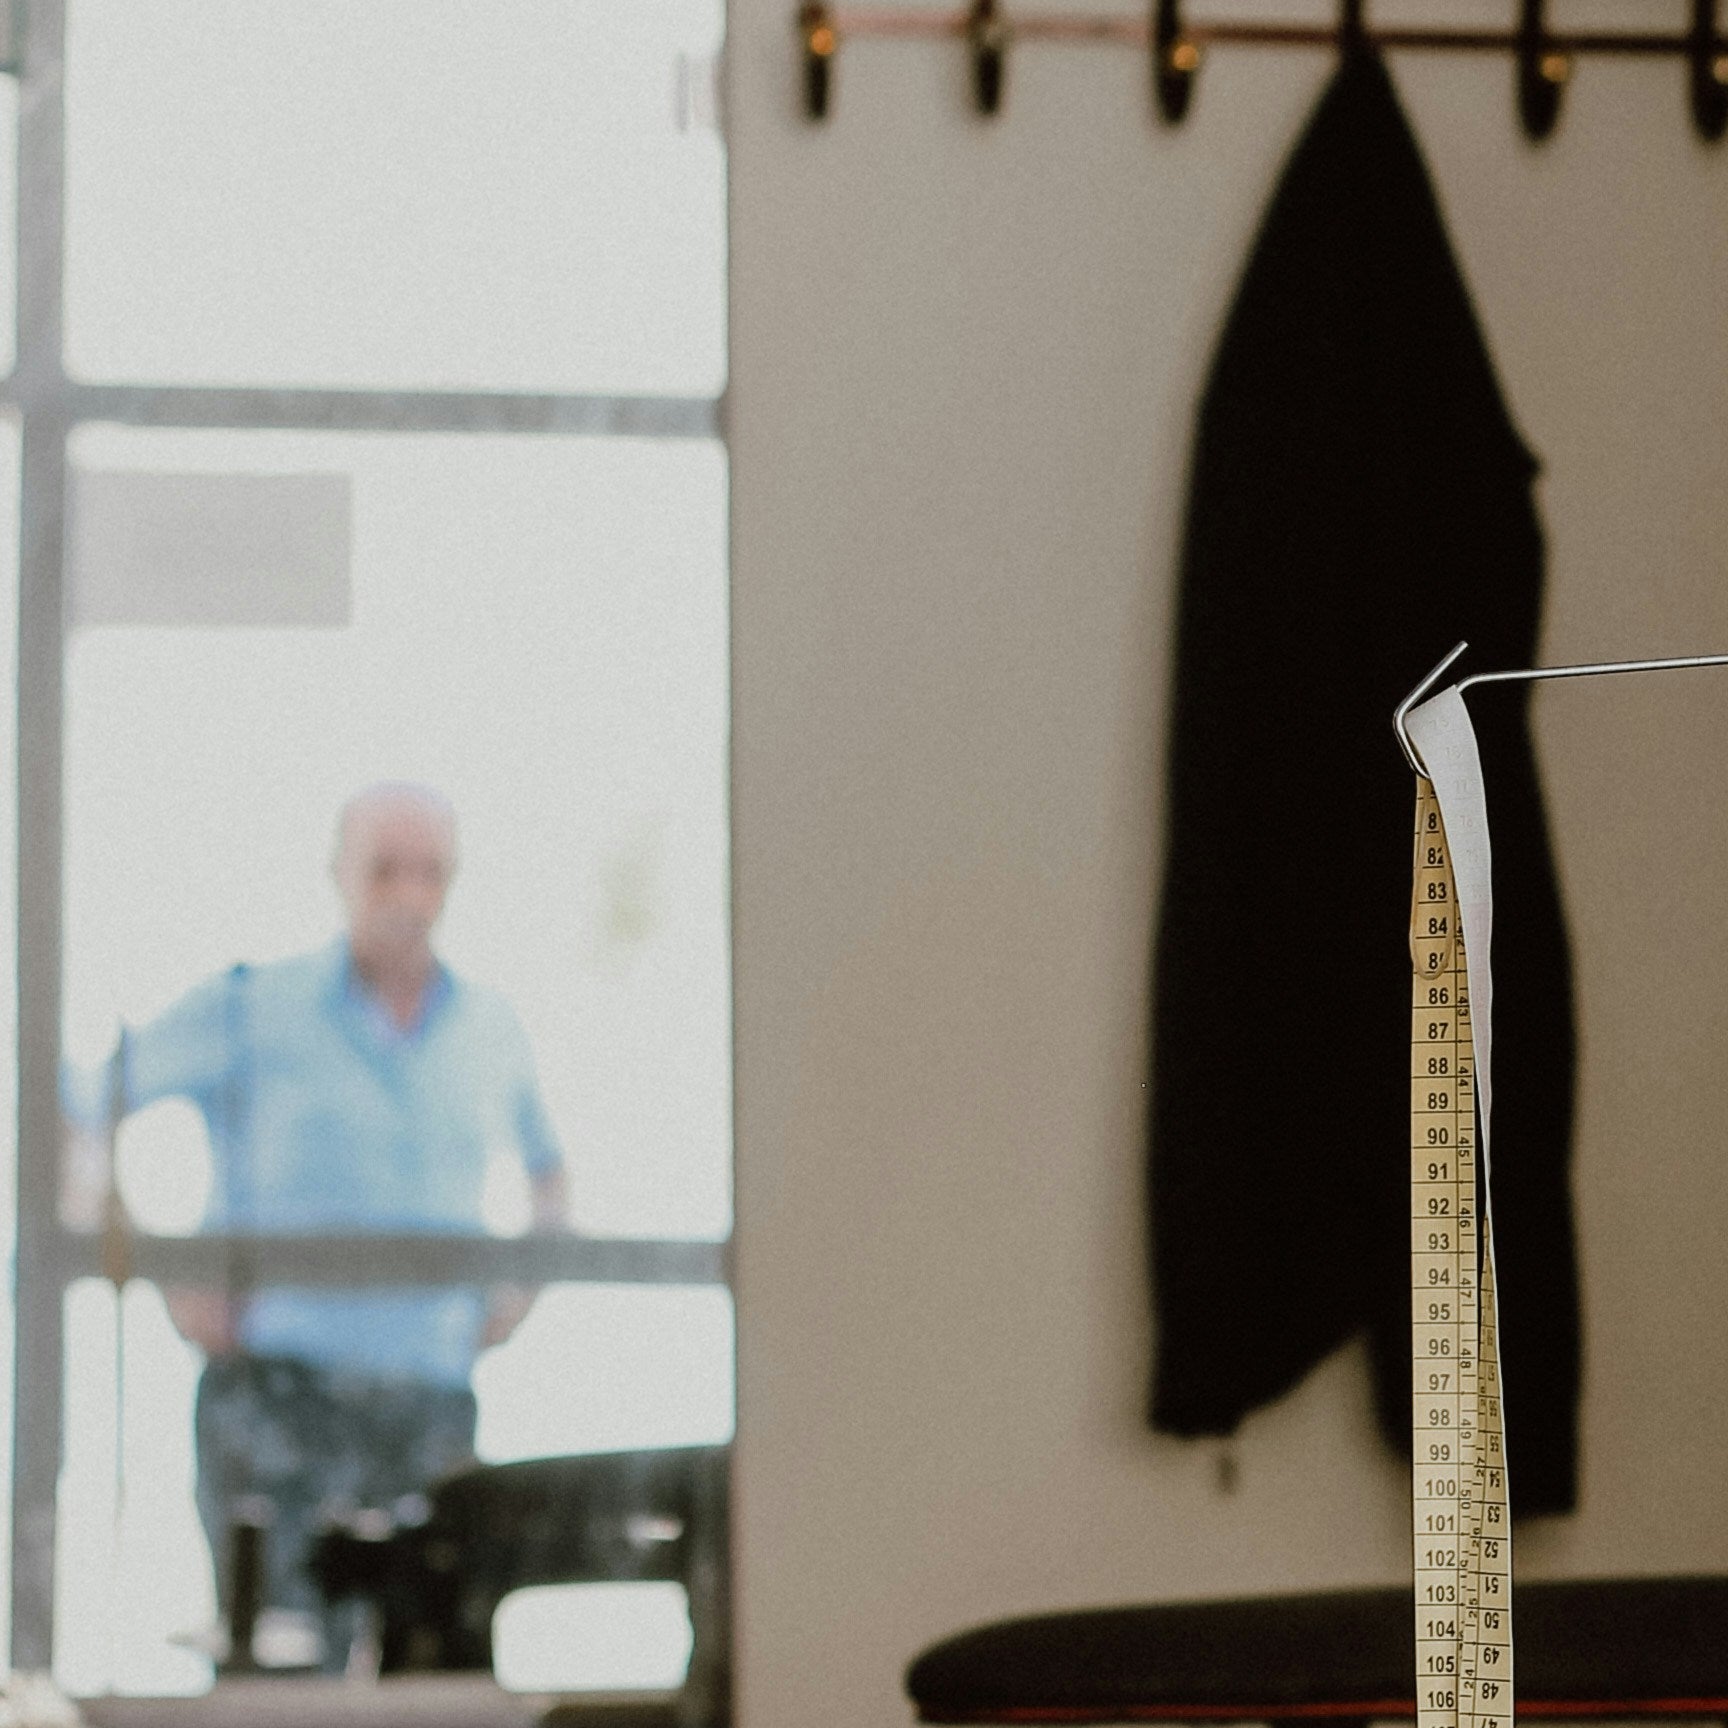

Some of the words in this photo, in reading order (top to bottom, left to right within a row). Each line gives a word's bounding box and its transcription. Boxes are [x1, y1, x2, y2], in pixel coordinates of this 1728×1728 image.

[1428, 882, 1446, 900] 83
[1428, 917, 1448, 934] 84
[1428, 987, 1449, 1004] 86
[1428, 1023, 1449, 1039] 87
[1428, 1057, 1448, 1074] 88
[1427, 1092, 1448, 1110] 89
[1427, 1127, 1449, 1145] 90
[1427, 1163, 1448, 1180] 91
[1428, 1198, 1450, 1215] 92
[1428, 1233, 1450, 1250] 93
[1428, 1268, 1450, 1285] 94
[1428, 1303, 1450, 1320] 95
[1429, 1338, 1450, 1355] 96
[1429, 1373, 1450, 1391] 97
[1429, 1409, 1450, 1426] 98
[1429, 1444, 1450, 1461] 99
[1425, 1479, 1456, 1496] 100
[1426, 1514, 1454, 1531] 101
[1487, 1506, 1500, 1523] 53
[1426, 1550, 1456, 1567] 102
[1484, 1541, 1499, 1559] 52
[1426, 1585, 1455, 1602] 103
[1485, 1577, 1499, 1594] 51
[1427, 1620, 1455, 1637] 104
[1484, 1612, 1499, 1629] 50
[1427, 1655, 1454, 1673] 105
[1483, 1647, 1500, 1665] 49
[1428, 1691, 1454, 1708] 106
[1482, 1682, 1499, 1700] 48
